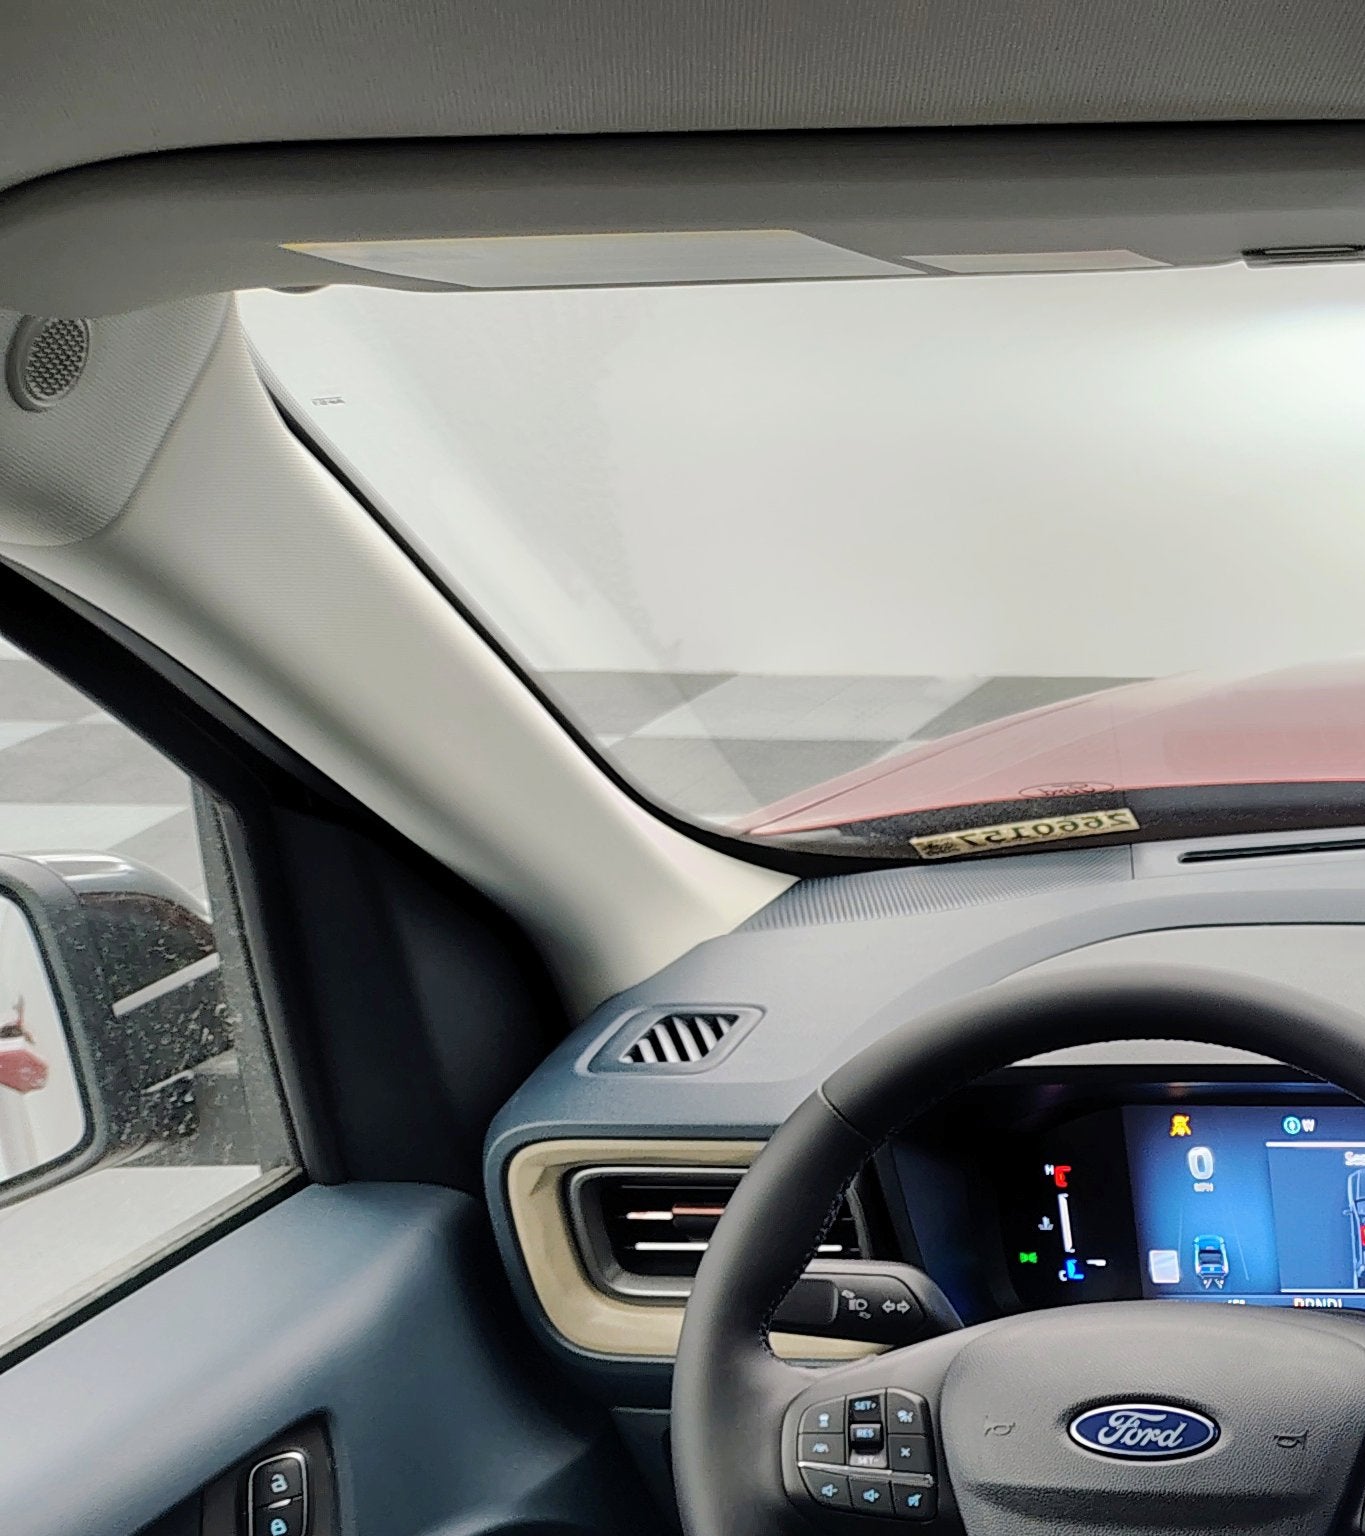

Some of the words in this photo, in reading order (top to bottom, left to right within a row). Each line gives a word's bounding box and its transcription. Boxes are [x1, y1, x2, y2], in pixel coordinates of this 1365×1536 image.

[1301, 1118, 1315, 1132] W
[1188, 1146, 1214, 1180] 0
[1097, 1410, 1188, 1448] Ford
